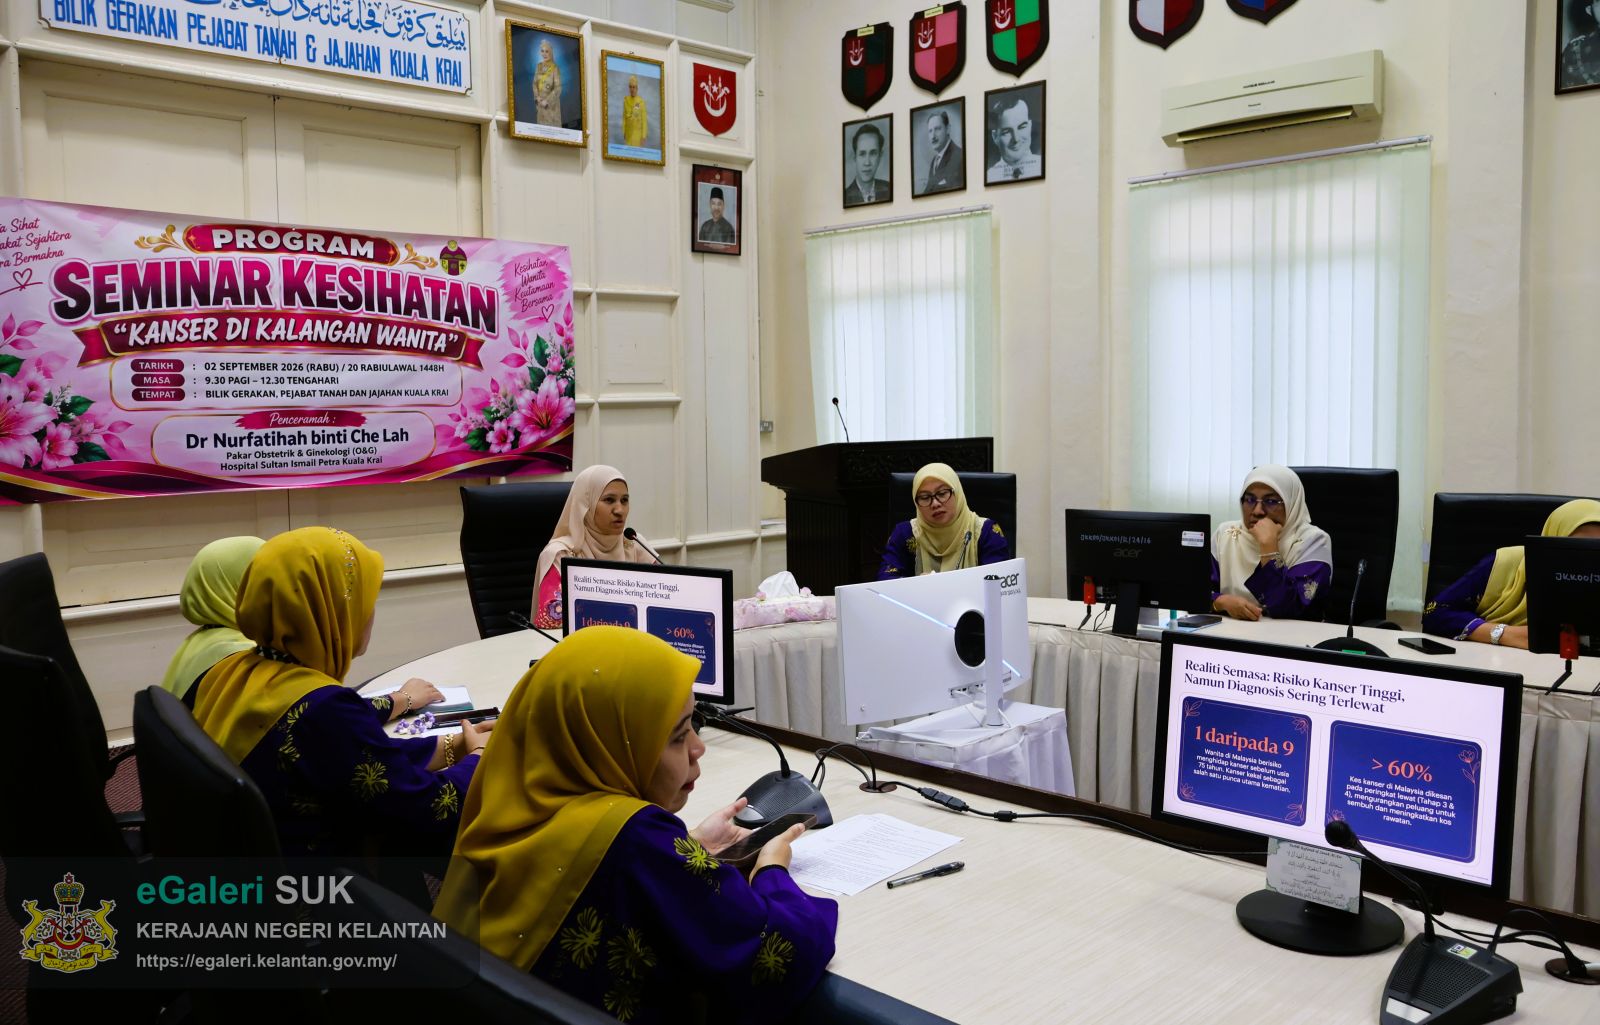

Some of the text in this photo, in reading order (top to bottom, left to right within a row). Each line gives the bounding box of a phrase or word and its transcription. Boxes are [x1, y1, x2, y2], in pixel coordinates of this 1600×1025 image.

[54, 0, 97, 27] BILIK
[106, 0, 178, 40] GERAKAN
[187, 12, 248, 52] PEJABAT
[254, 24, 298, 60] TANAH
[306, 34, 316, 63] &
[324, 38, 381, 74] JAJAHAN
[390, 49, 429, 82] KUALA
[436, 57, 462, 87] KRAI
[10, 217, 40, 232] Sihat
[26, 230, 72, 250] Sejahtera
[211, 228, 375, 260] PROGRAM
[12, 247, 64, 266] Bermakna
[522, 270, 546, 287] Wanita
[53, 259, 498, 334] SEMINAR KESIHATAN
[521, 294, 553, 312] Bersama
[226, 318, 249, 341] DI
[255, 317, 372, 345] KALANGAN
[139, 362, 174, 370] TARIKH
[204, 362, 216, 371] 02
[220, 362, 278, 371] SEPTEMBER
[281, 363, 303, 371] 2026
[306, 363, 339, 373] (RABU)
[348, 363, 358, 372] 20
[360, 364, 417, 372] RABIULAWAL
[140, 390, 176, 398] TEMPAT
[206, 390, 229, 398] BILIK
[232, 390, 278, 399] GERAKAN,
[280, 390, 317, 399] PEJABAT
[369, 389, 402, 398] JAJAHAN
[269, 412, 330, 427] Penceramah
[186, 428, 408, 449] Dr Nurfatihah binti Che Lah
[227, 446, 377, 460] Pakar Obstetrik & Ginekologi (O&G)
[220, 456, 383, 472] Hospital Sultan Ismail Petra Kuala Krai
[1112, 548, 1143, 558] acer
[617, 579, 635, 588] Risiko
[636, 581, 657, 589] Kanser
[658, 582, 680, 592] Tinggi,
[1000, 573, 1019, 588] acer
[574, 584, 671, 600] Namun Diagnosis Sering Terlewat
[673, 627, 694, 639] 60%
[1185, 660, 1405, 702] Realiti Semasa: Risiko Kanser Tinggi,
[1184, 673, 1384, 713] Namun Diagnosis Sering Terlewat
[1195, 726, 1294, 756] 1 daripada 9
[1197, 756, 1228, 766] menghidap
[1230, 760, 1249, 769] kanser
[1250, 765, 1275, 774] sebelum
[1204, 748, 1224, 758] Wanita
[1232, 753, 1257, 764] Malaysia
[1258, 758, 1282, 768] berisiko
[1206, 764, 1224, 772] tahun.
[1226, 768, 1245, 777] Kanser
[1246, 772, 1262, 780] kekal
[1263, 775, 1286, 785] sebagai
[1372, 758, 1432, 782] > 60%
[1242, 779, 1260, 787] utama
[1262, 782, 1291, 793] kematian.
[1363, 778, 1385, 788] kanser
[1395, 784, 1423, 795] Malaysia
[1425, 790, 1452, 800] dikesan
[1354, 793, 1404, 808] mengurangkan
[1406, 803, 1433, 815] peluang
[1435, 808, 1456, 818] untuk
[1364, 786, 1396, 798] peringkat
[1398, 792, 1416, 802] lewat
[1417, 796, 1440, 808] (Tahap
[1347, 800, 1374, 810] sembuh
[1389, 807, 1438, 822] meningkatkan
[1383, 814, 1412, 826] rawatan.
